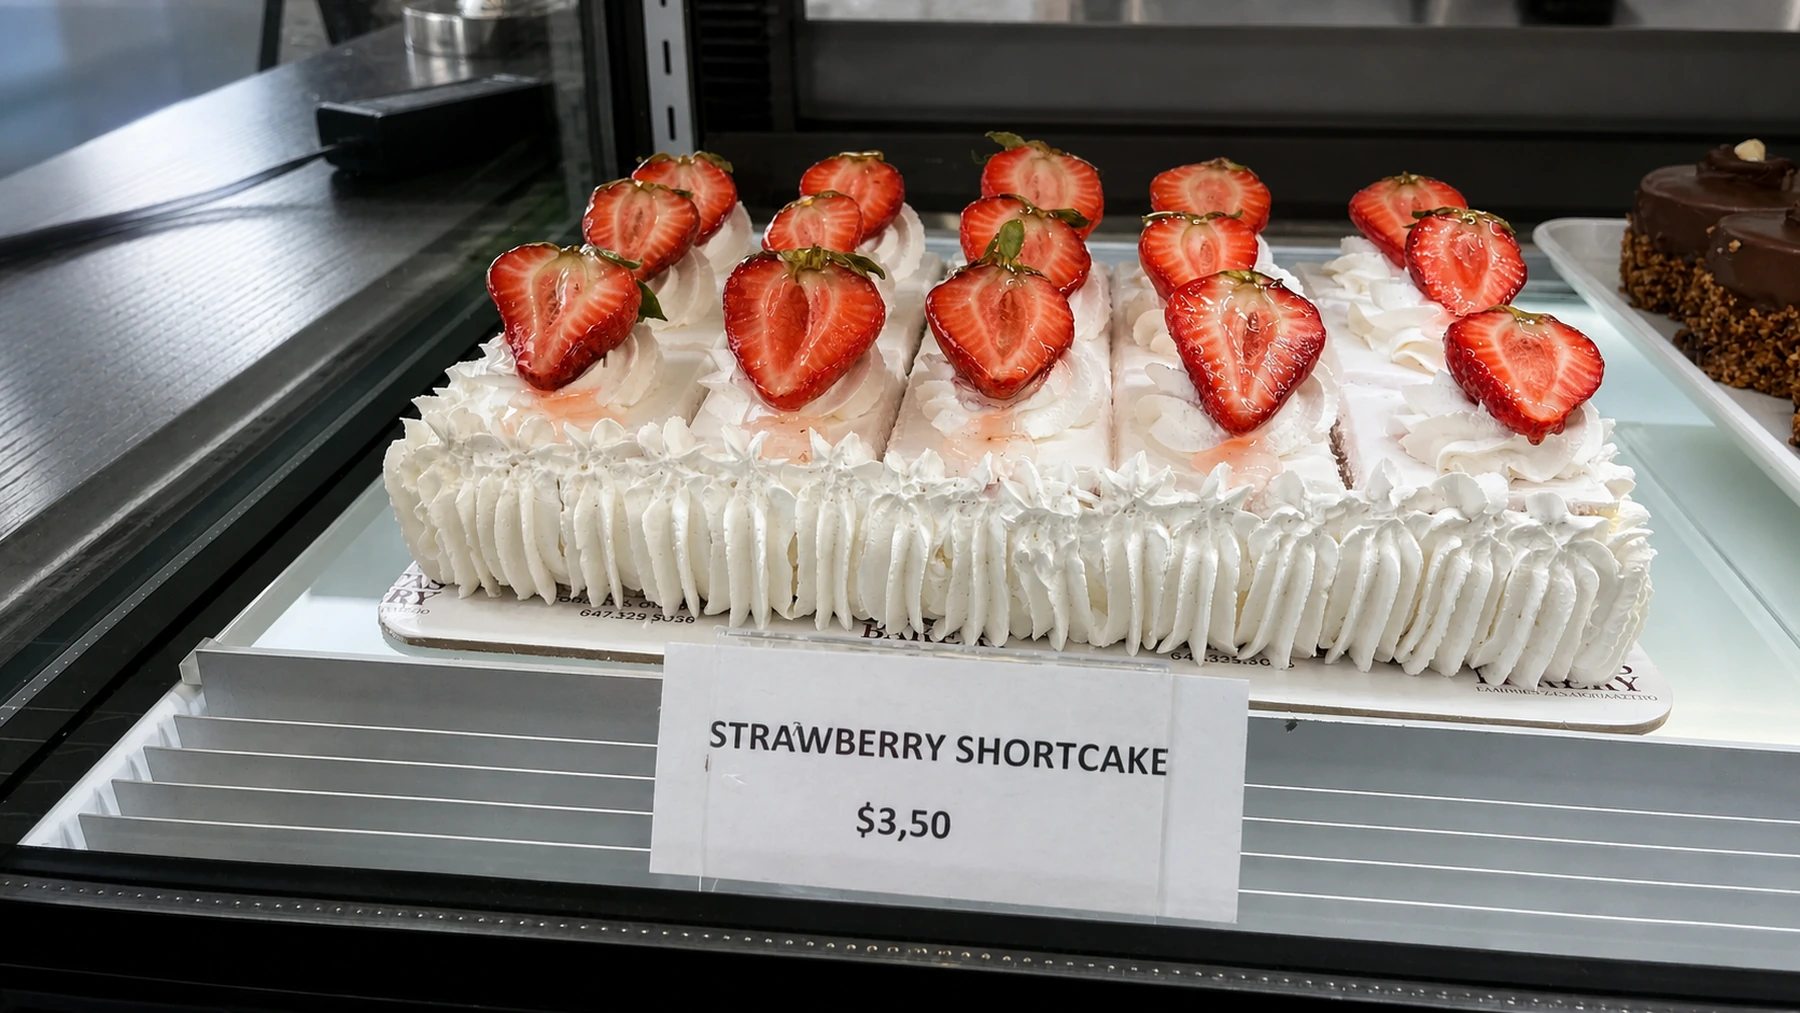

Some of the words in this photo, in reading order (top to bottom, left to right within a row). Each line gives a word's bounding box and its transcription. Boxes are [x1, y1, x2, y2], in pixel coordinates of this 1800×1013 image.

[709, 719, 946, 762] STRAWBERRY
[955, 734, 1168, 777] SHORTCAKE
[856, 801, 952, 843] $3,50
